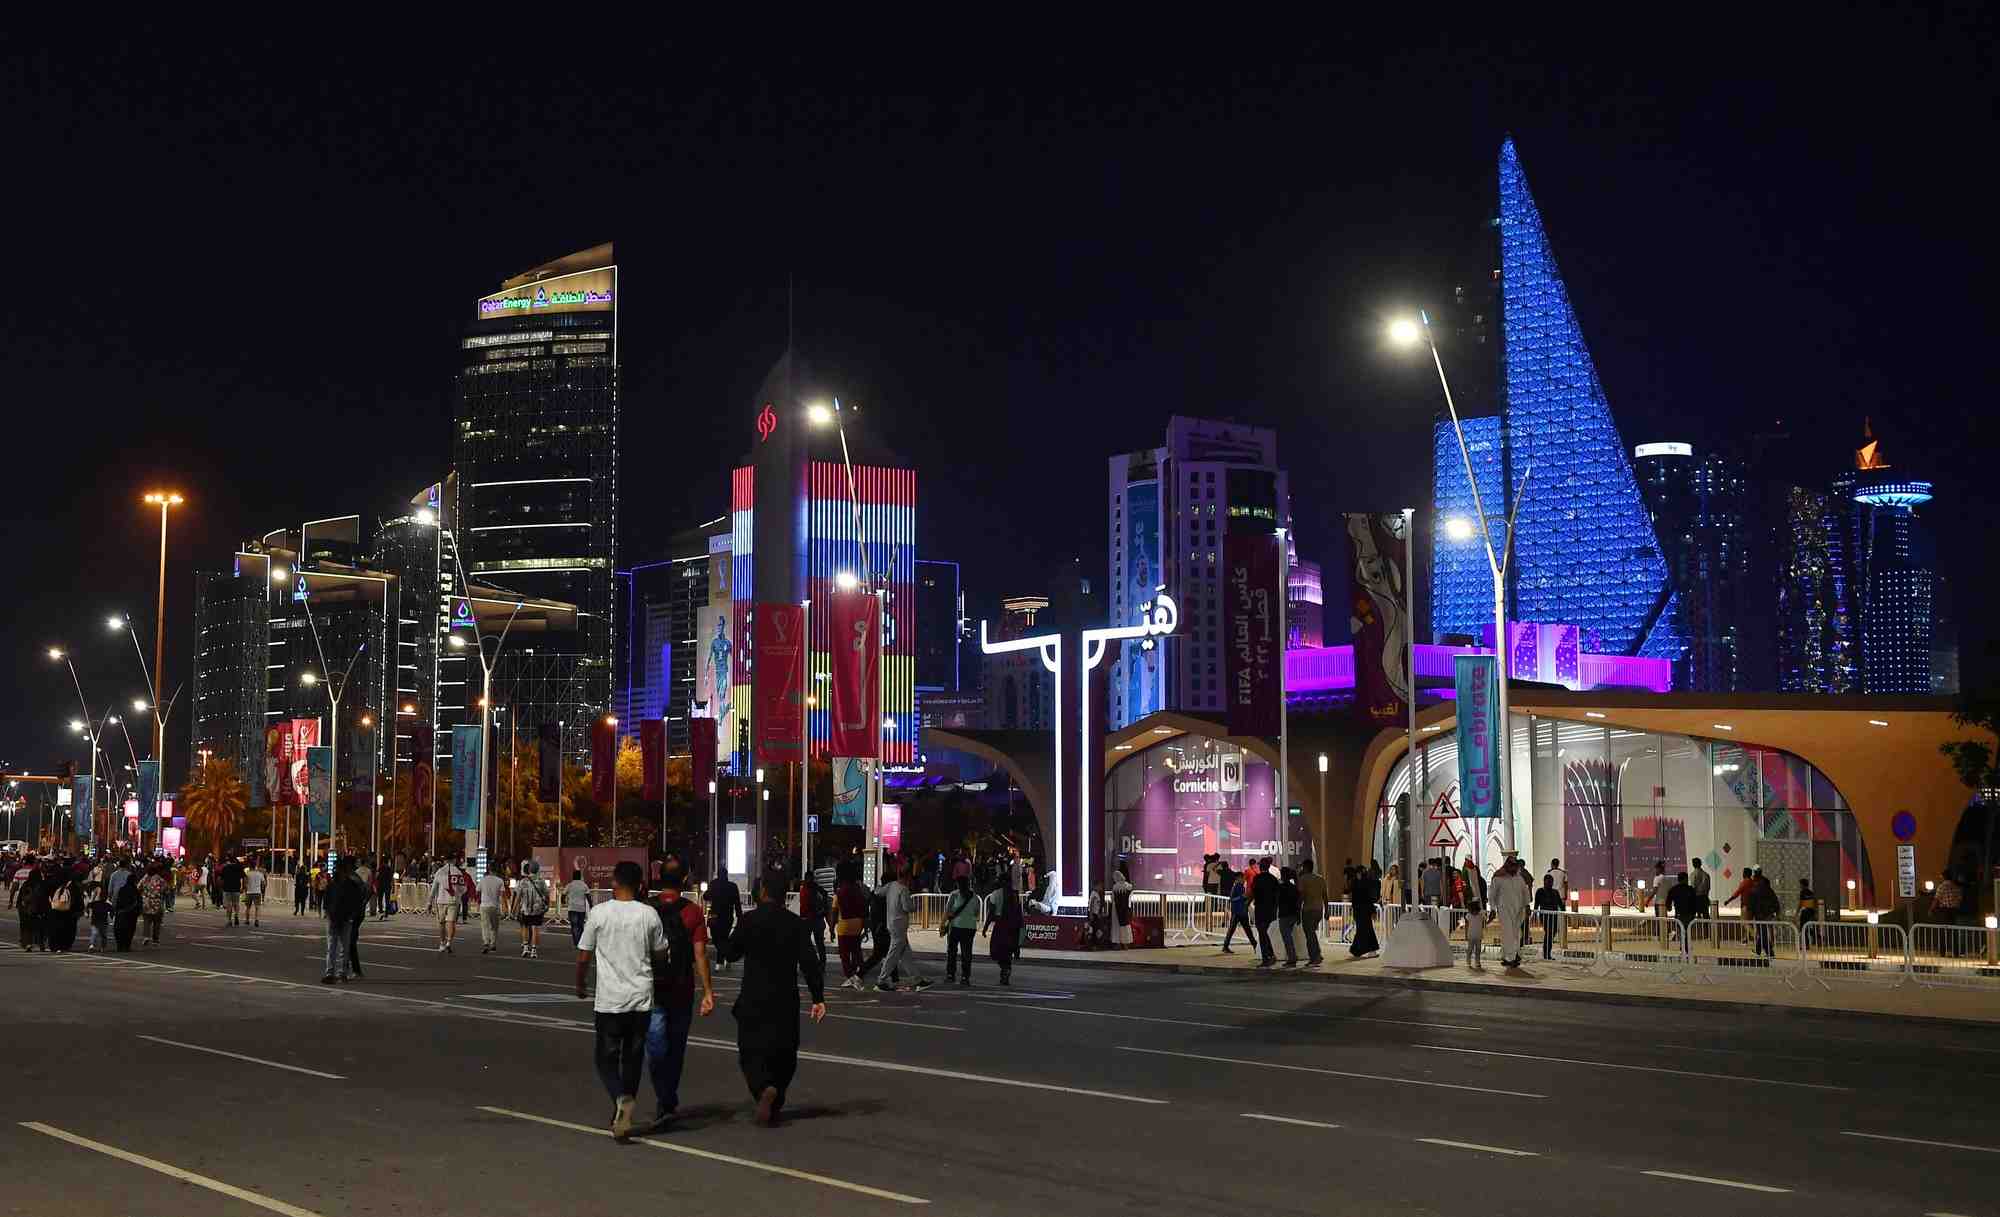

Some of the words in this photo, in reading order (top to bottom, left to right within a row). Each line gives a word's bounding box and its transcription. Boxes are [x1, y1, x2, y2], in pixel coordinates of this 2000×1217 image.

[481, 298, 531, 313] QatarEnergy
[1238, 667, 1252, 705] FIFA
[1173, 752, 1218, 774] الكورنيش
[1173, 778, 1220, 793] Corniche
